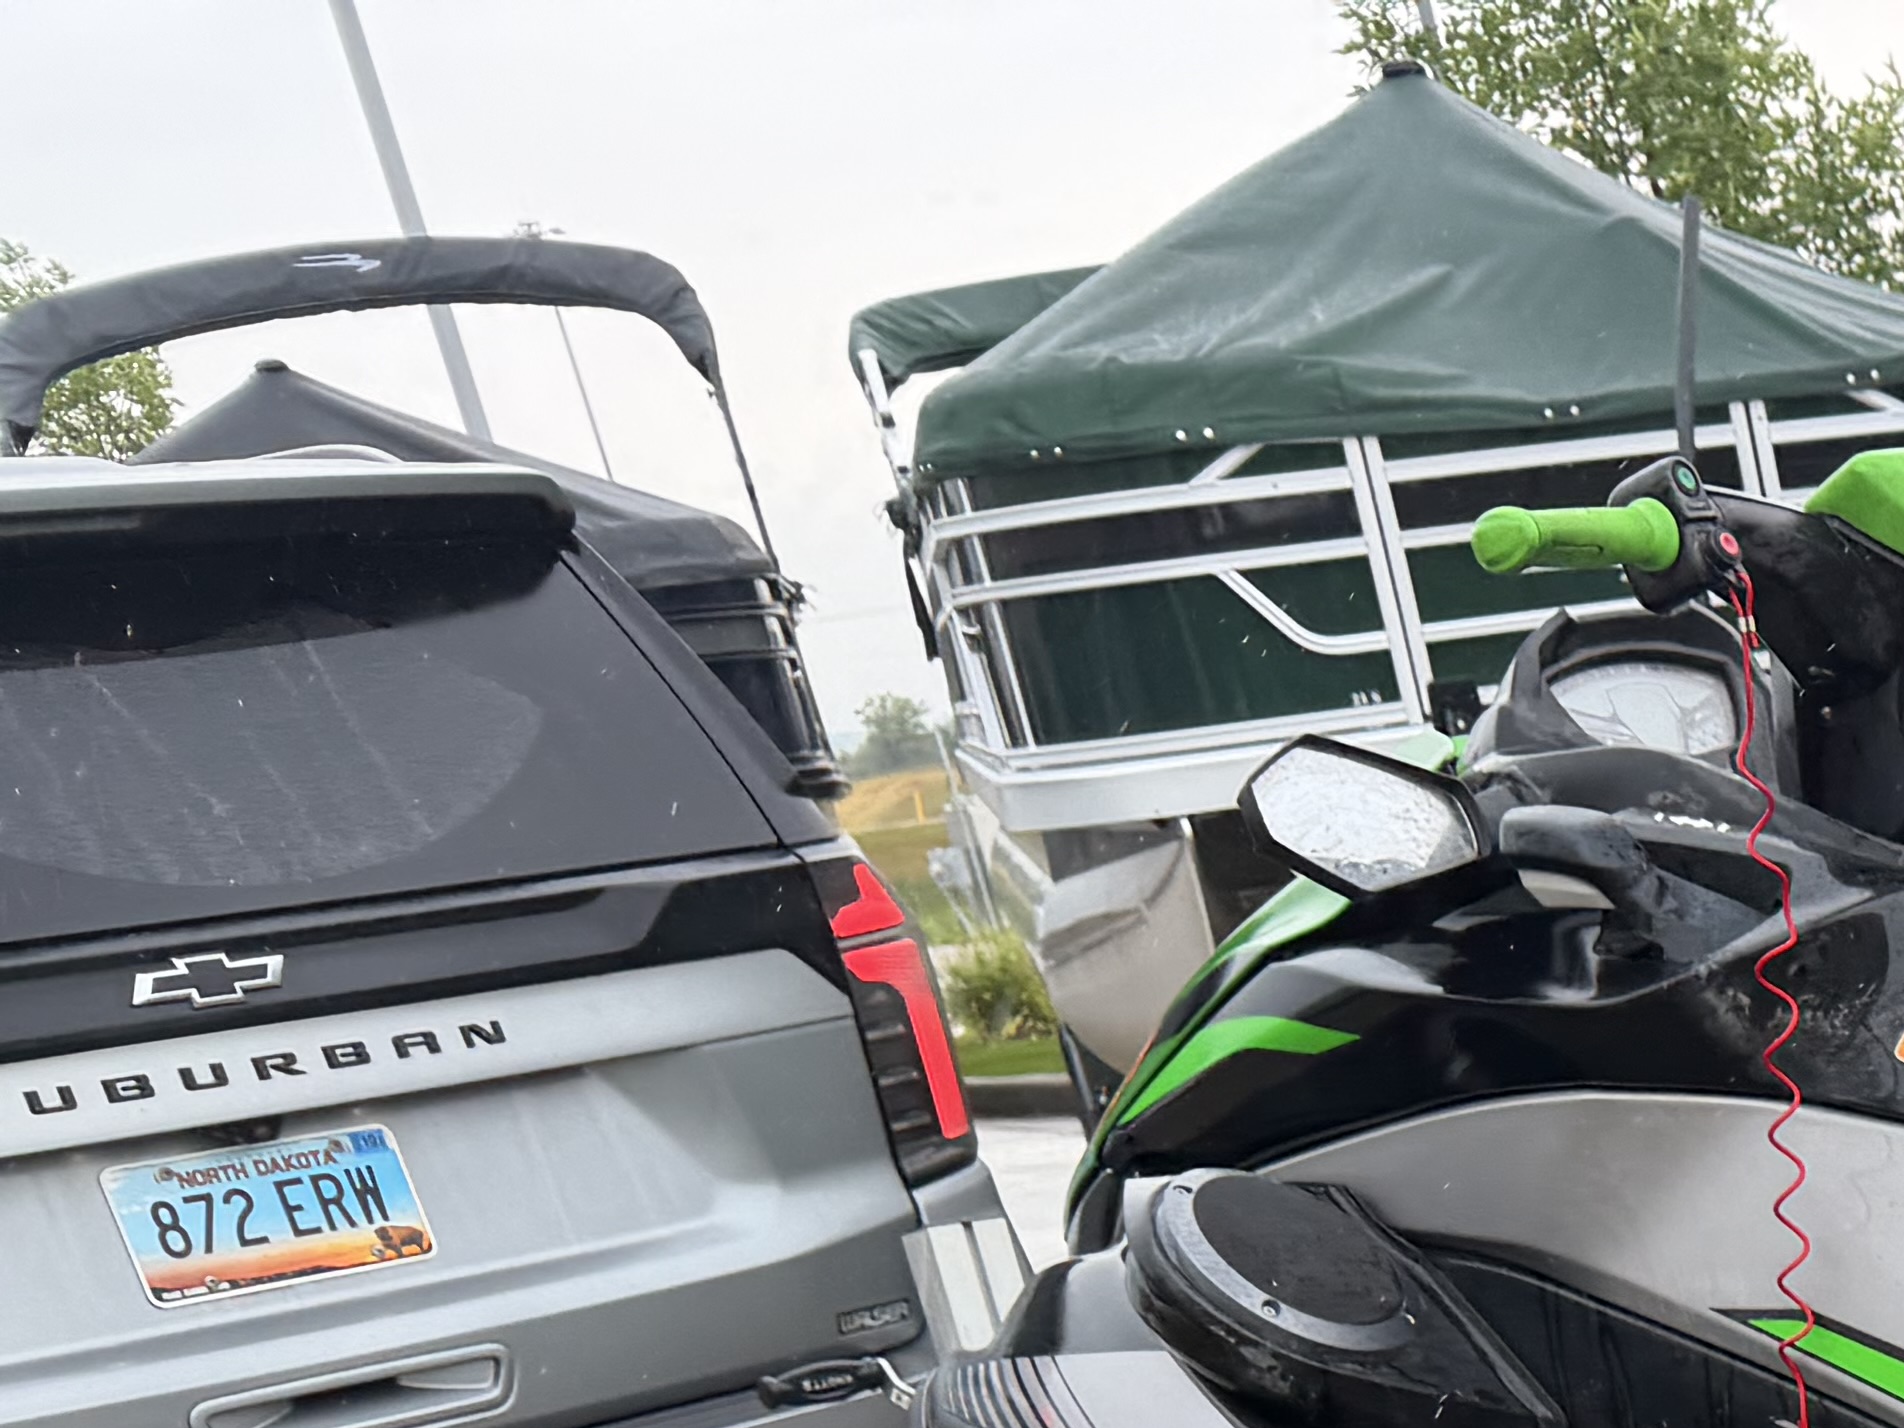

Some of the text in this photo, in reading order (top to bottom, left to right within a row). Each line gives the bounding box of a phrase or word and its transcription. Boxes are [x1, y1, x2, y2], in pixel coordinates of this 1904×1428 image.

[174, 1150, 338, 1189] NORTH DAKOTA
[150, 1165, 390, 1259] 872 ERW
